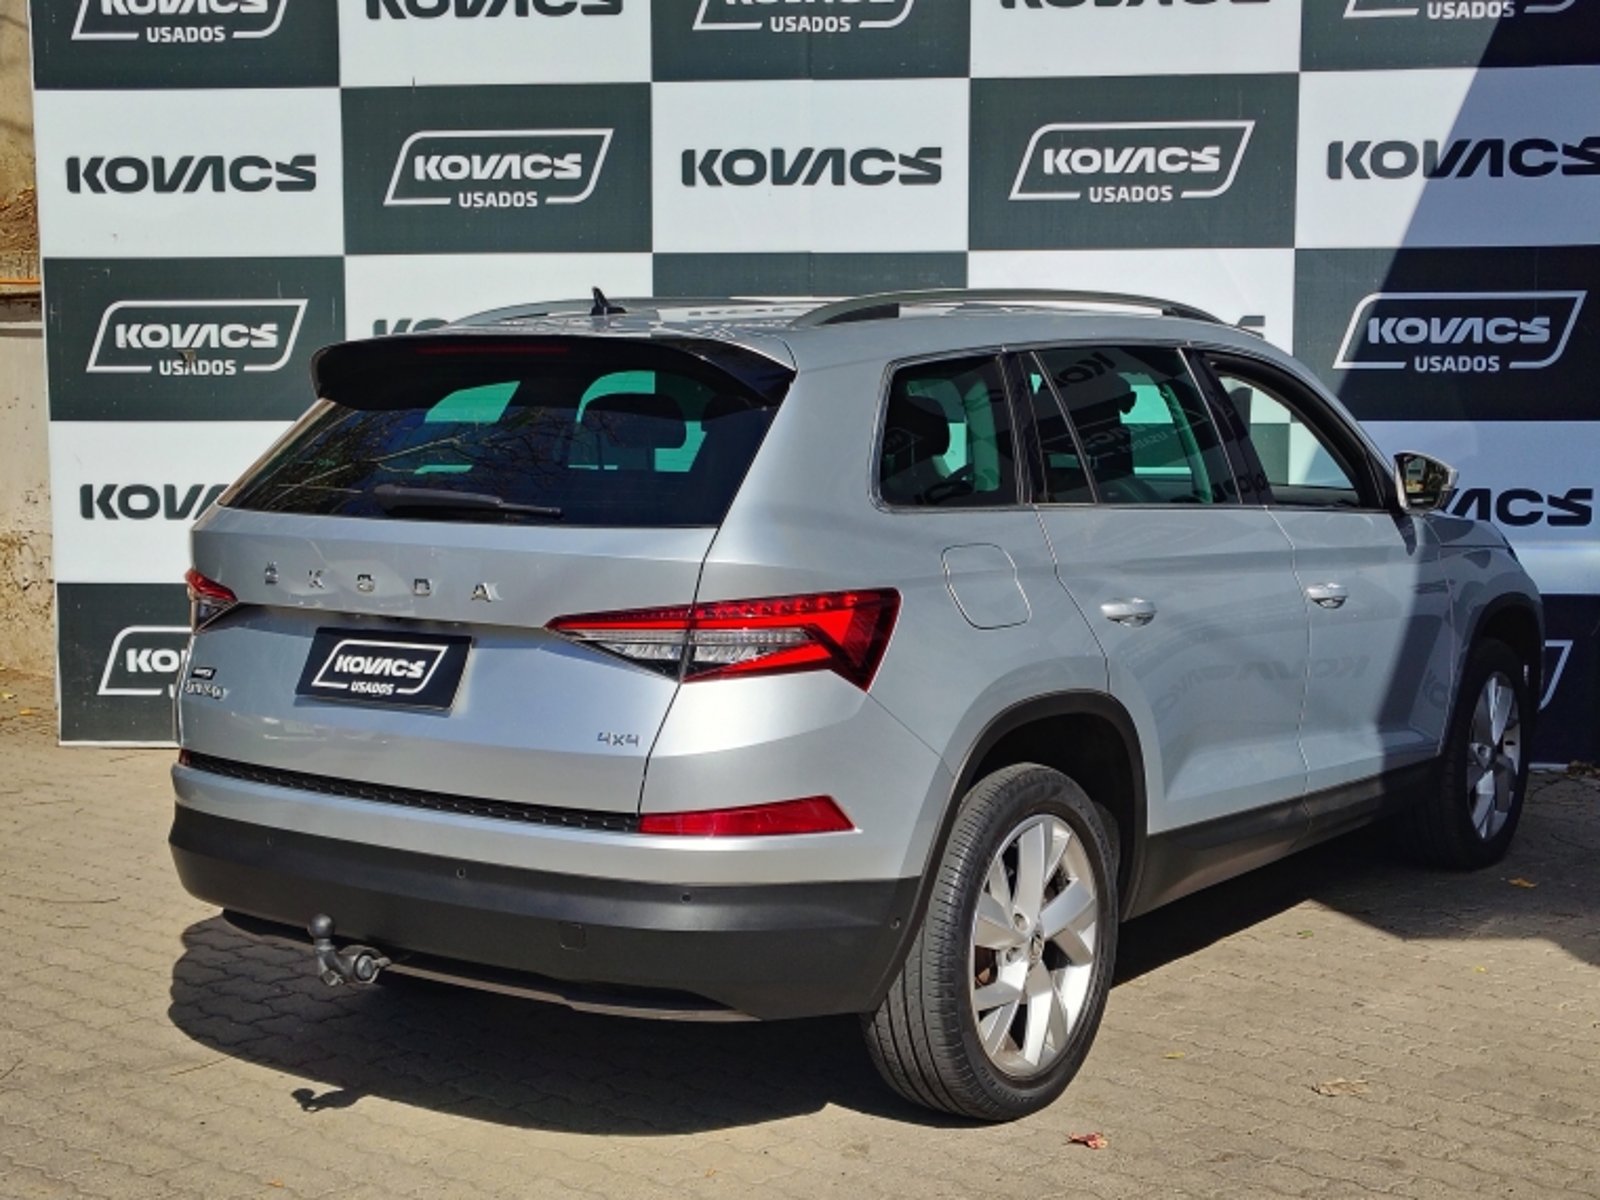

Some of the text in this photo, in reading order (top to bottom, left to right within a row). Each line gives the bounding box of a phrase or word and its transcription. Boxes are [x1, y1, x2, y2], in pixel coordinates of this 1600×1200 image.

[1427, 1, 1515, 19] USADOS
[147, 26, 226, 42] USADOS
[770, 16, 850, 32] USADOS
[414, 153, 582, 181] KOVACS
[682, 147, 941, 187] KOVACS
[1043, 147, 1220, 175] KOVACS
[1328, 138, 1600, 179] KOVACS
[66, 155, 316, 194] KOVACS
[458, 191, 538, 208] USADOS
[1089, 186, 1173, 203] USADOS
[116, 323, 279, 349] KOVACS
[1368, 317, 1550, 344] KOVACS
[159, 359, 237, 376] USADOS
[1414, 355, 1500, 372] USADOS
[1439, 488, 1593, 526] ACS
[334, 655, 427, 678] KOVACS
[350, 680, 395, 696] USADOS
